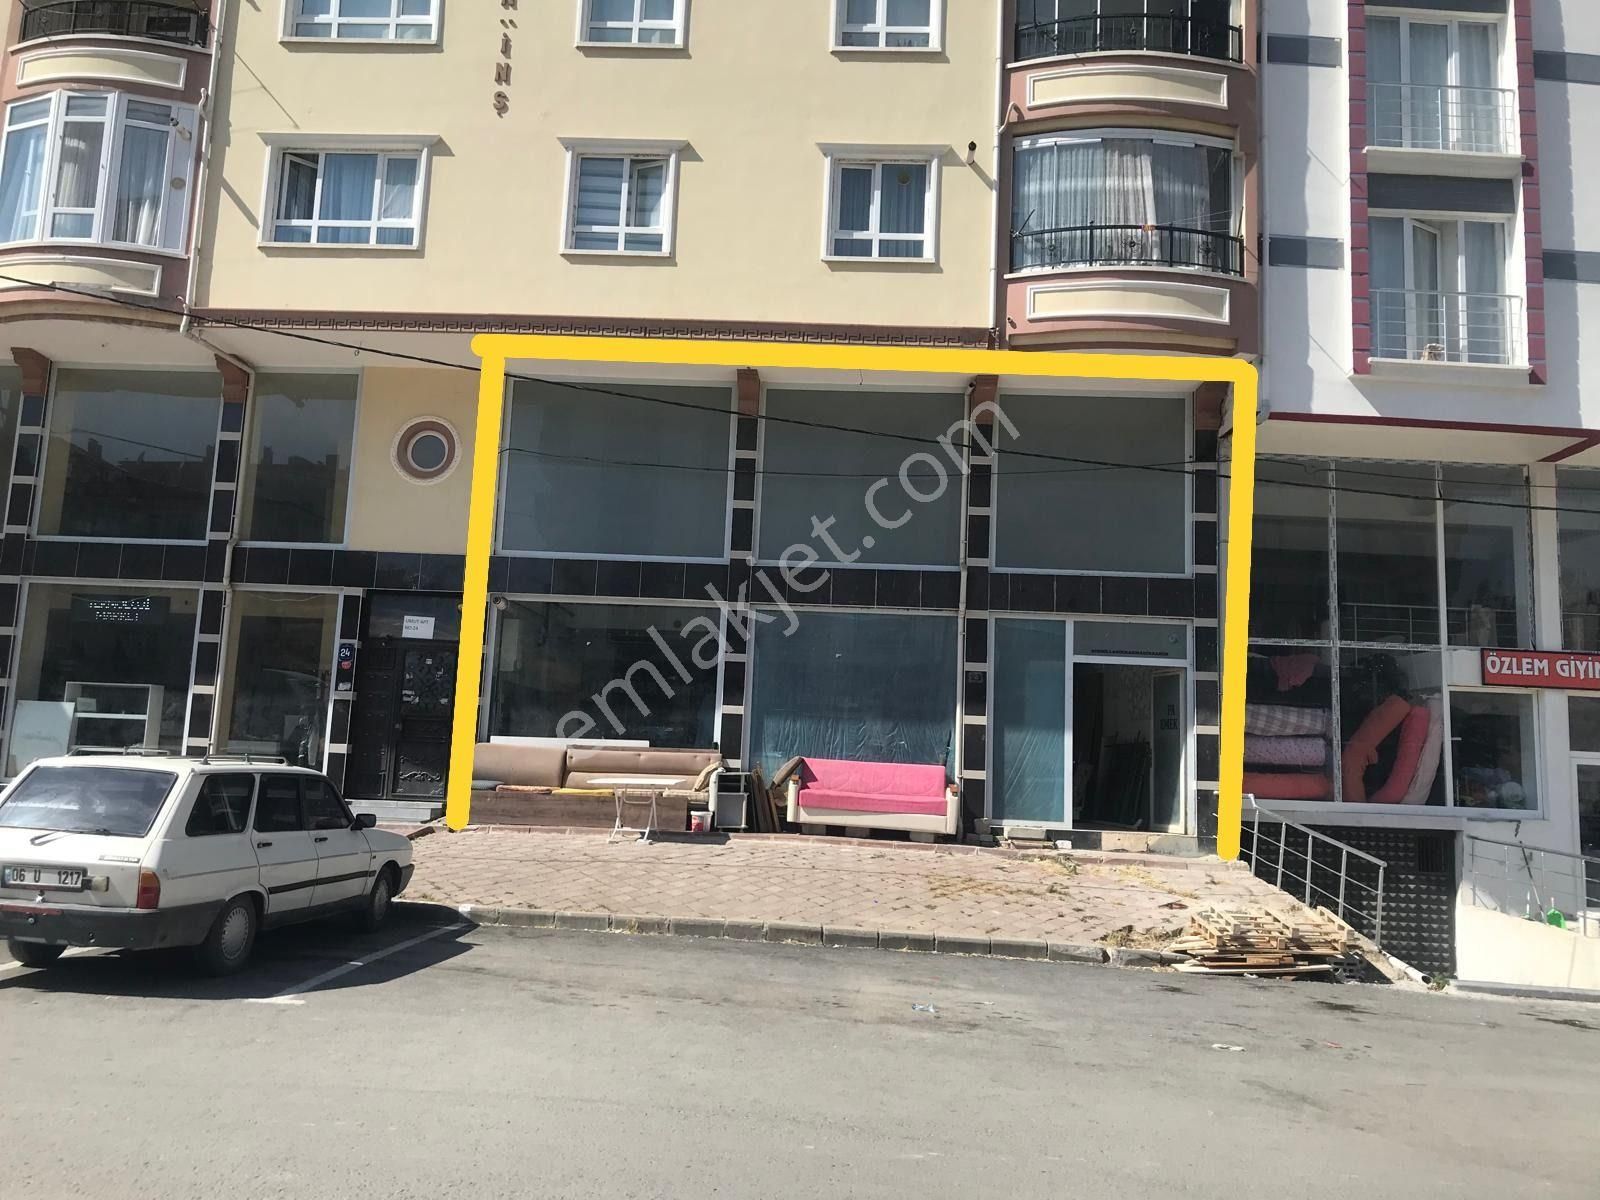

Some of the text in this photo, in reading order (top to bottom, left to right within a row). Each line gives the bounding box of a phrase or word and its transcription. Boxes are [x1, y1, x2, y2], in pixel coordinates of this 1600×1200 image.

[340, 648, 351, 657] 24
[1486, 652, 1549, 676] ÖZLEM
[12, 868, 82, 886] 06 U 1217
